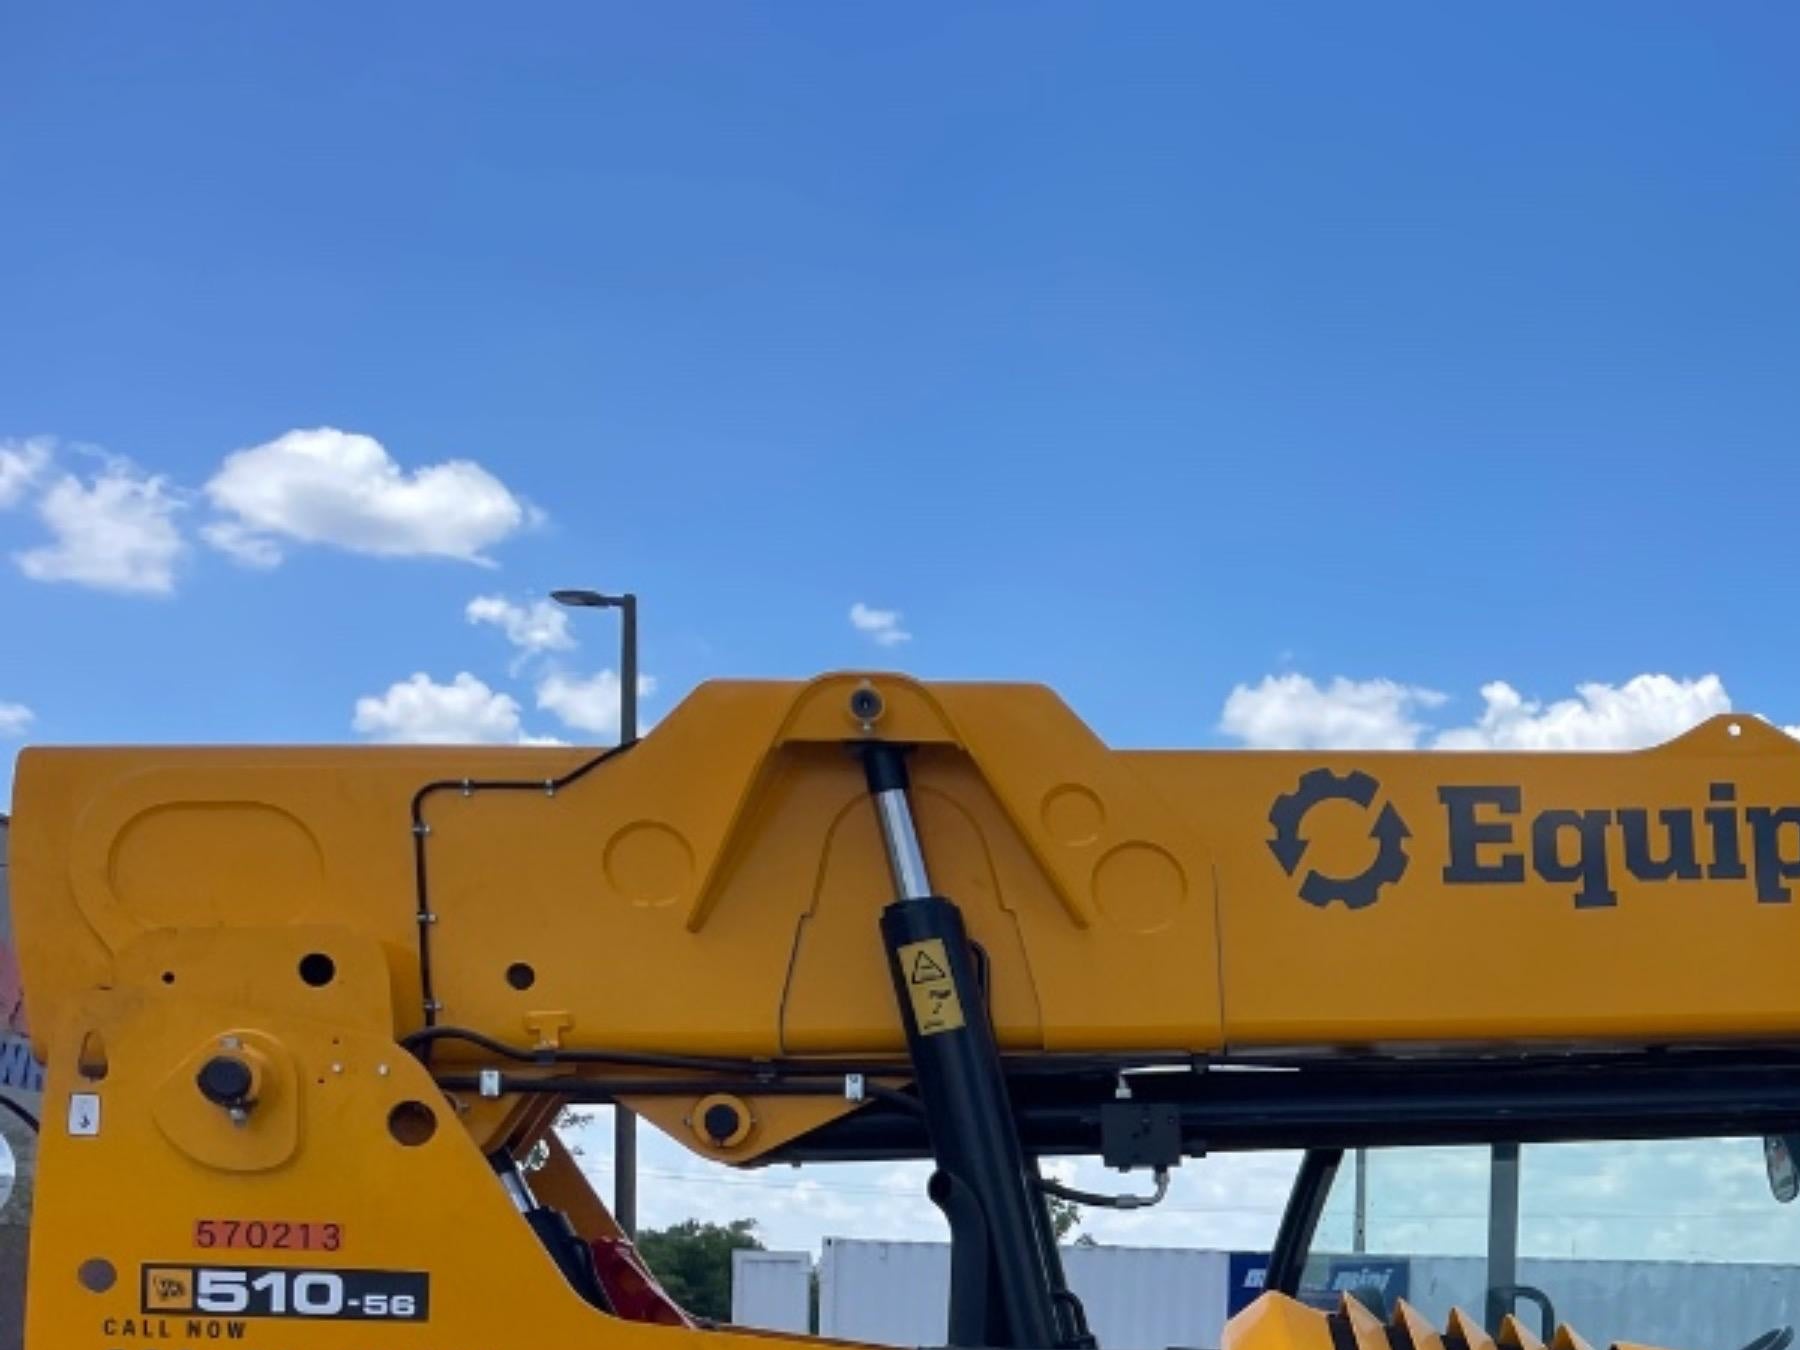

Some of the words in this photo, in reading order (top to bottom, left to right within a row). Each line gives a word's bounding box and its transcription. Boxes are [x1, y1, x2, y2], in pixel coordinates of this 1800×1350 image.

[196, 1219, 342, 1252] 570213
[197, 1270, 415, 1316] 510-56
[103, 1318, 171, 1338] CALL
[187, 1321, 247, 1340] NOW
